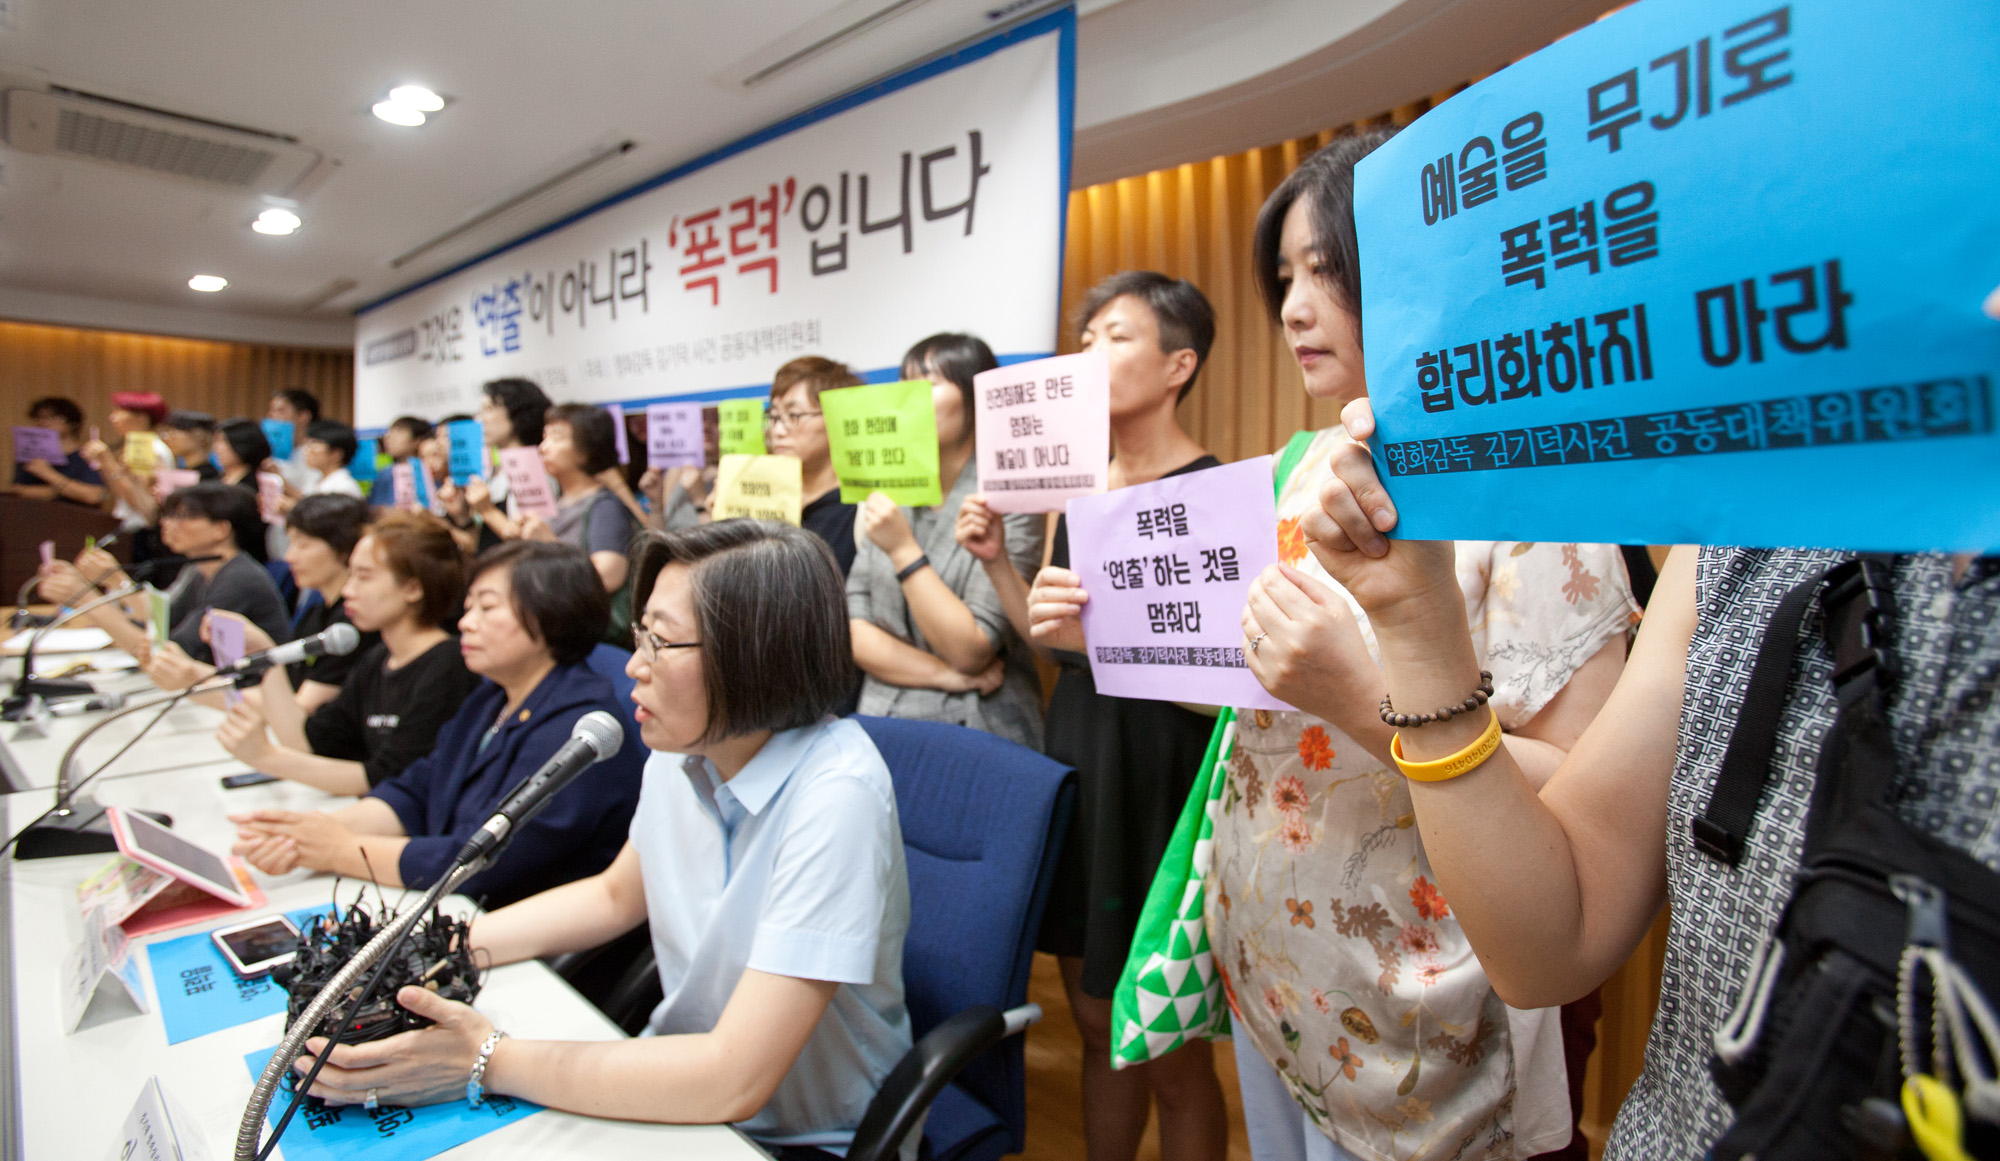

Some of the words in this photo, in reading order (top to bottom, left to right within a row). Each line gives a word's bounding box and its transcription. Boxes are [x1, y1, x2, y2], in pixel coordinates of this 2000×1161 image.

[1420, 110, 1548, 228] 예술을
[1586, 4, 1798, 155] 무기로
[1500, 180, 1661, 290] 폭력을
[559, 238, 652, 329] 아니라
[1415, 304, 1654, 414] 합리화하지
[1695, 259, 1855, 370] 마라
[1045, 375, 1073, 400] 만든
[1387, 429, 1475, 475] 영화감독
[1484, 420, 1634, 469] 김기덕사건
[1644, 376, 1983, 455] 공동대책위원회
[1034, 445, 1069, 468] 아니다
[1137, 503, 1189, 540] 폭력을
[1200, 546, 1240, 583] 것을
[1147, 601, 1202, 634] 멈춰라
[1138, 649, 1189, 665] 김기덕사건
[1193, 649, 1246, 668] 공동대책위
